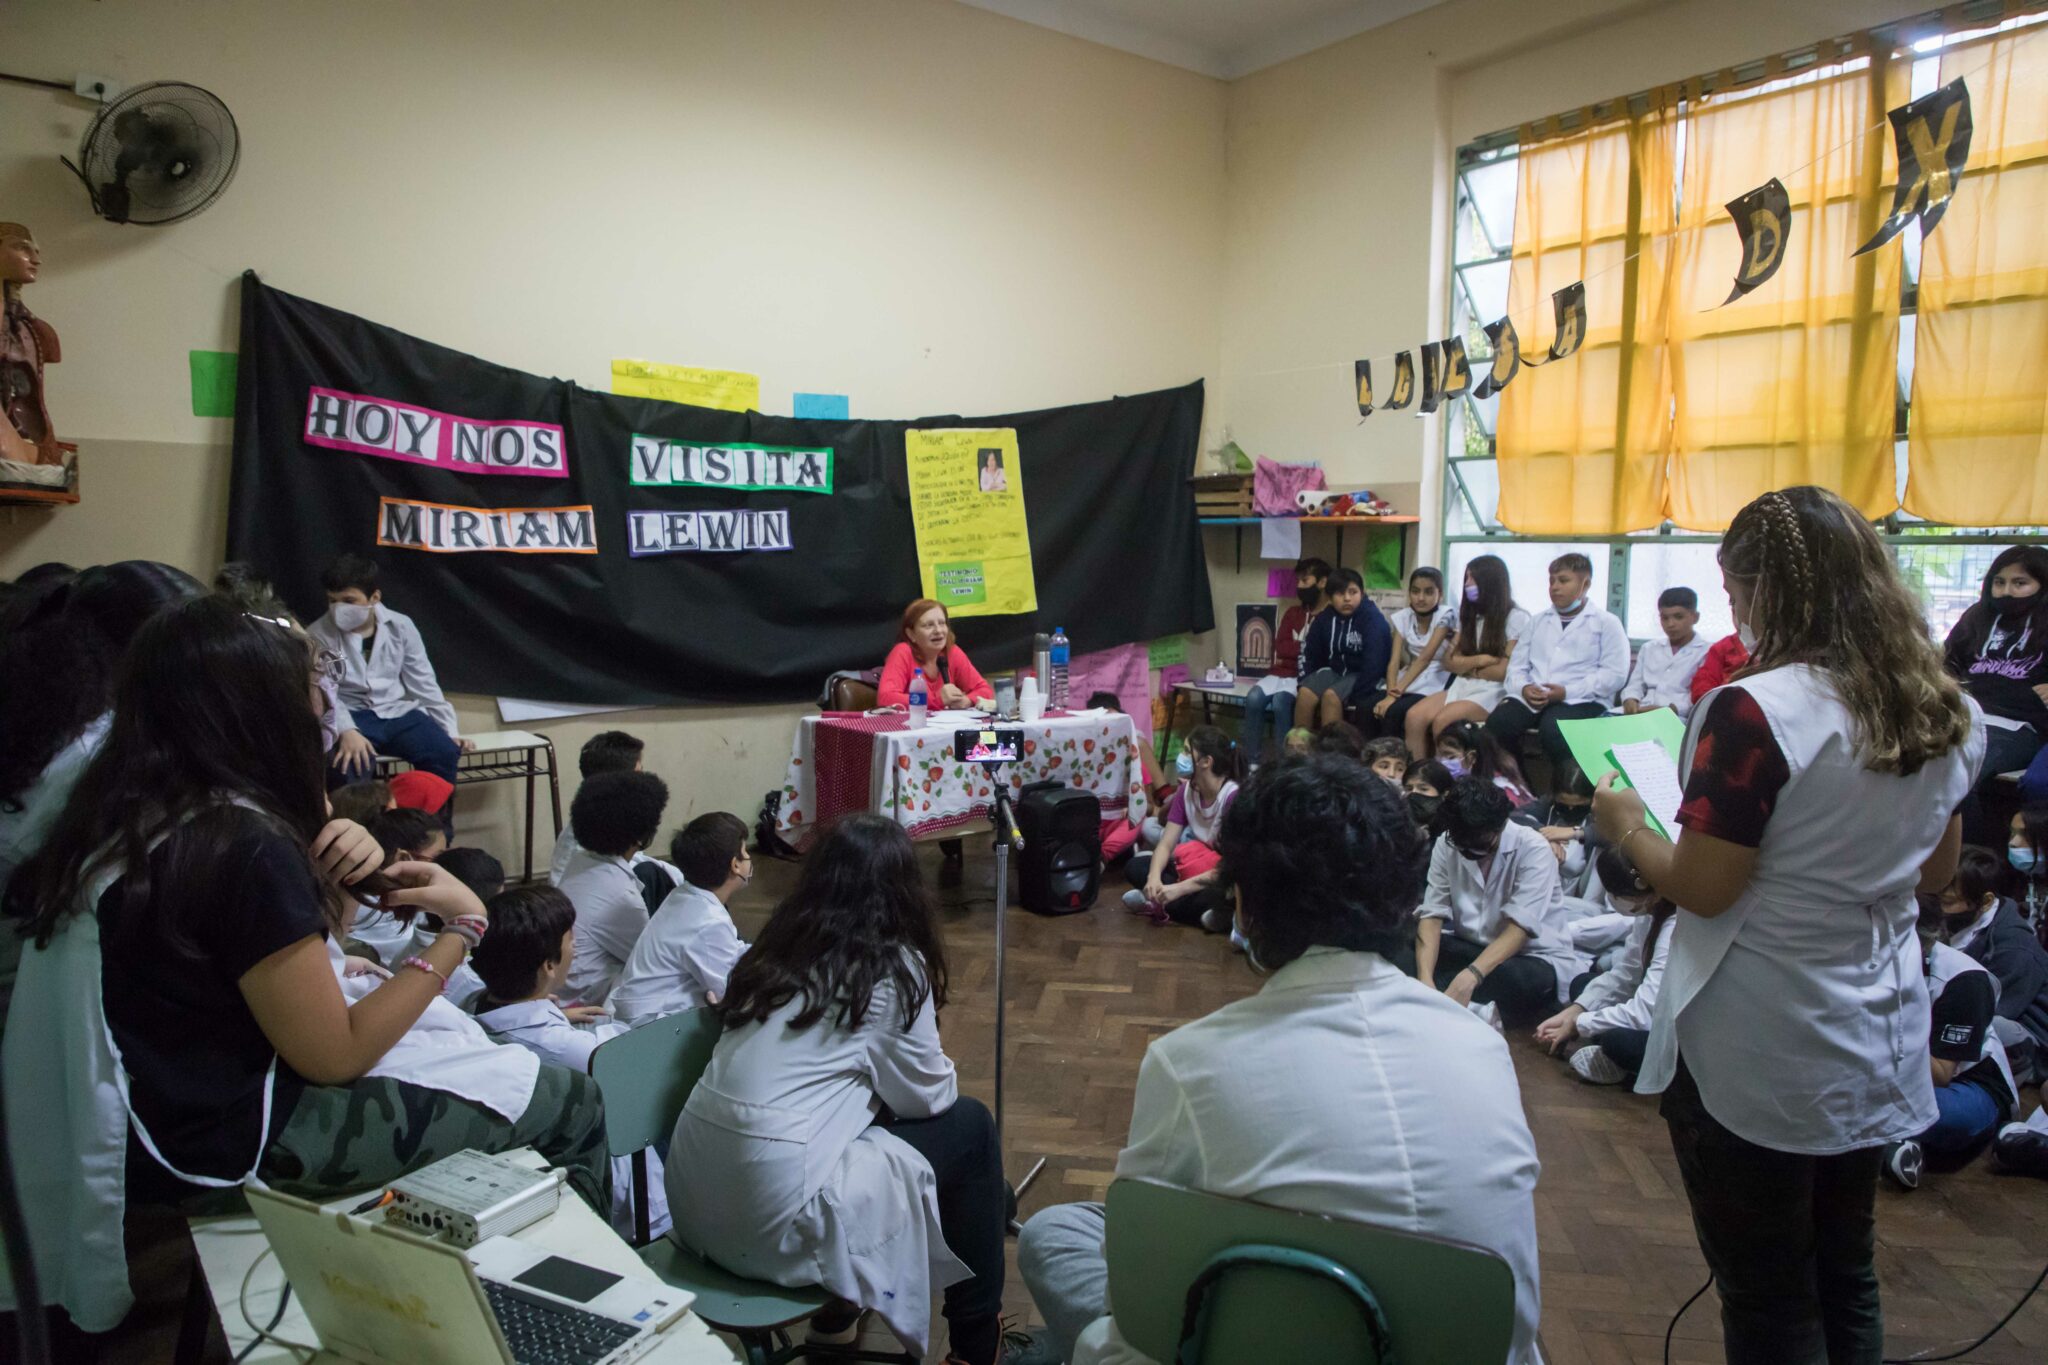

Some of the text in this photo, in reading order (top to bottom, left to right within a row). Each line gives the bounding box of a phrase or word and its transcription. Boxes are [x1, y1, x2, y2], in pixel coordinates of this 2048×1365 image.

[310, 394, 558, 467] HOY NOS
[635, 439, 825, 488] VISITA
[380, 502, 597, 548] MIRIAM
[632, 511, 788, 551] LEWIN
